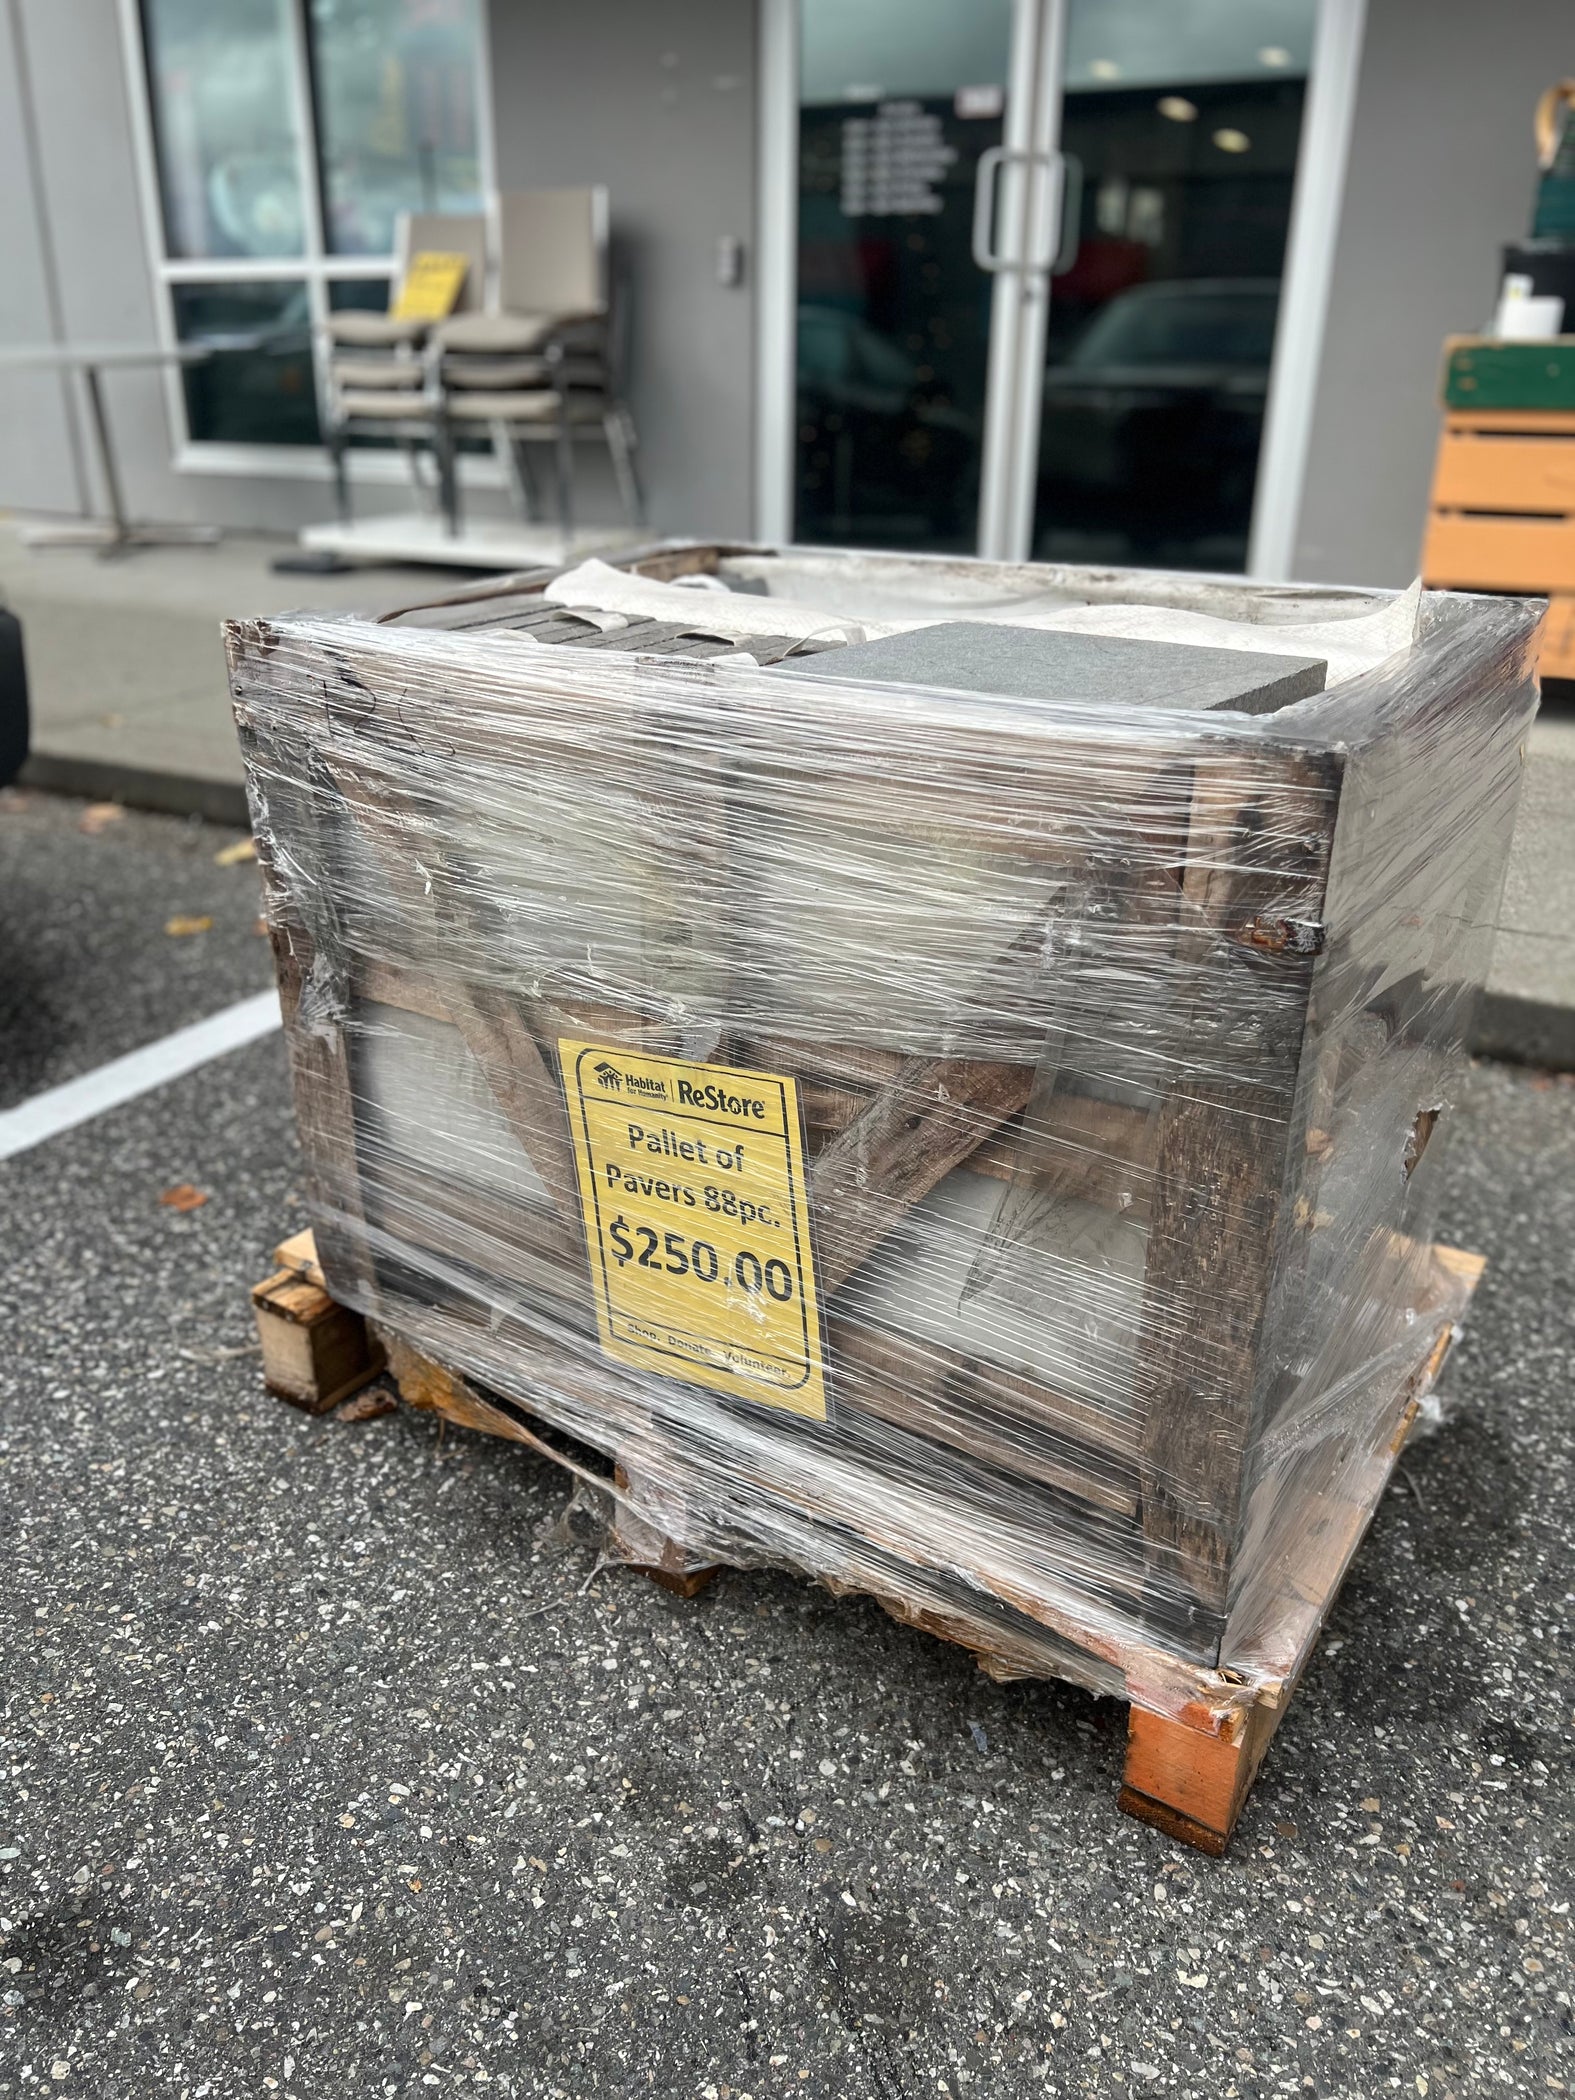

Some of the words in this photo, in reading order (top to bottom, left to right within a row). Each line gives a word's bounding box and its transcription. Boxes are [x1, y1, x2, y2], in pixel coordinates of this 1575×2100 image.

[625, 1073, 666, 1093] Habitat
[627, 1087, 637, 1095] for
[677, 1079, 766, 1120] ReStore
[627, 1124, 708, 1164] Pallet
[715, 1144, 745, 1172] of
[606, 1163, 696, 1207] Pavers
[703, 1185, 781, 1228] 88pc.
[609, 1215, 793, 1302] $250.00
